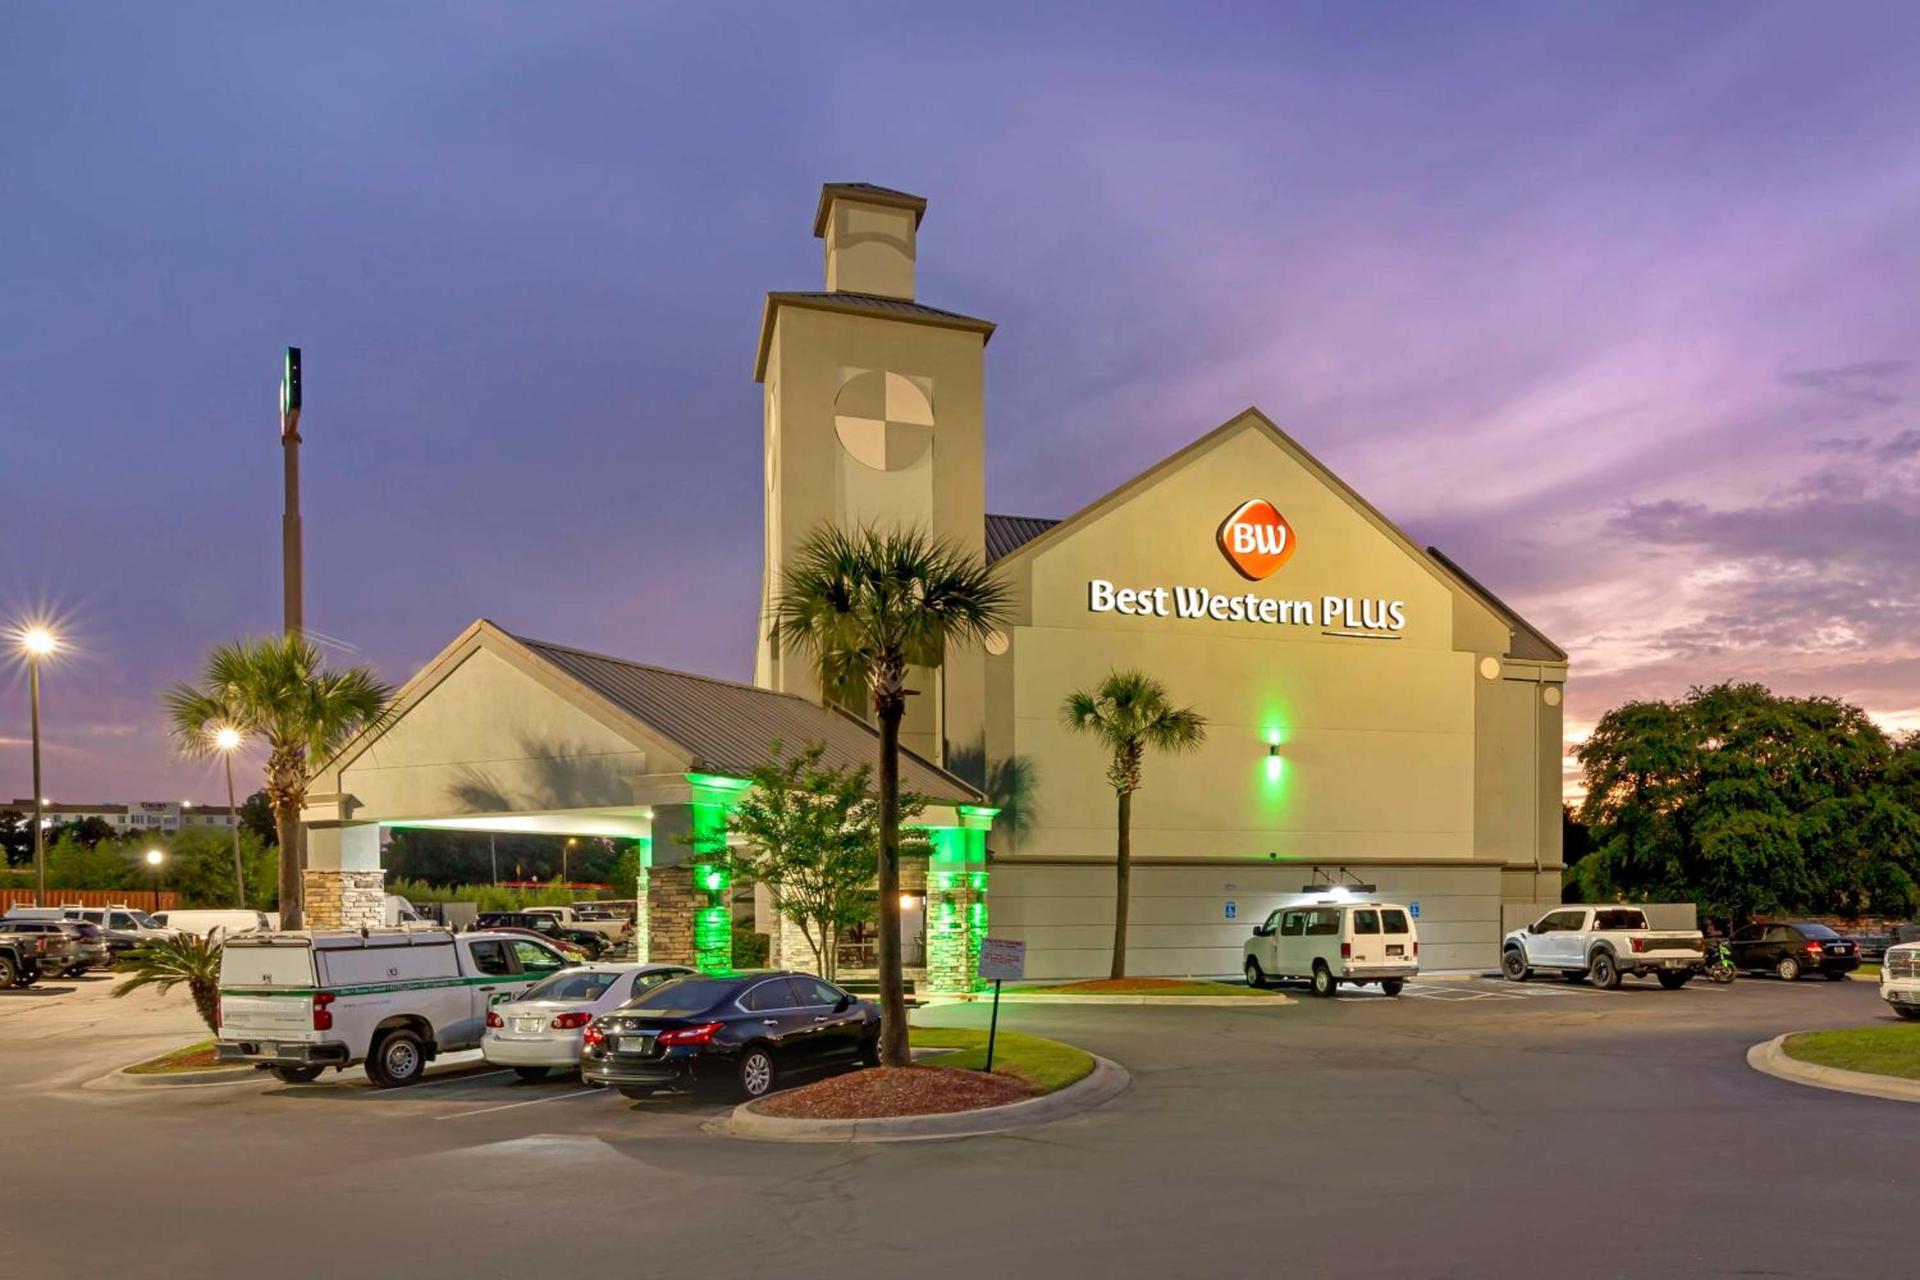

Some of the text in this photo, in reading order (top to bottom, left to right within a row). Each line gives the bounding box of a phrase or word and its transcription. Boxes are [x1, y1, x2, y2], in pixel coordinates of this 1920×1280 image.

[1233, 522, 1287, 555] BW
[1089, 579, 1406, 630] Best Western PLUS
